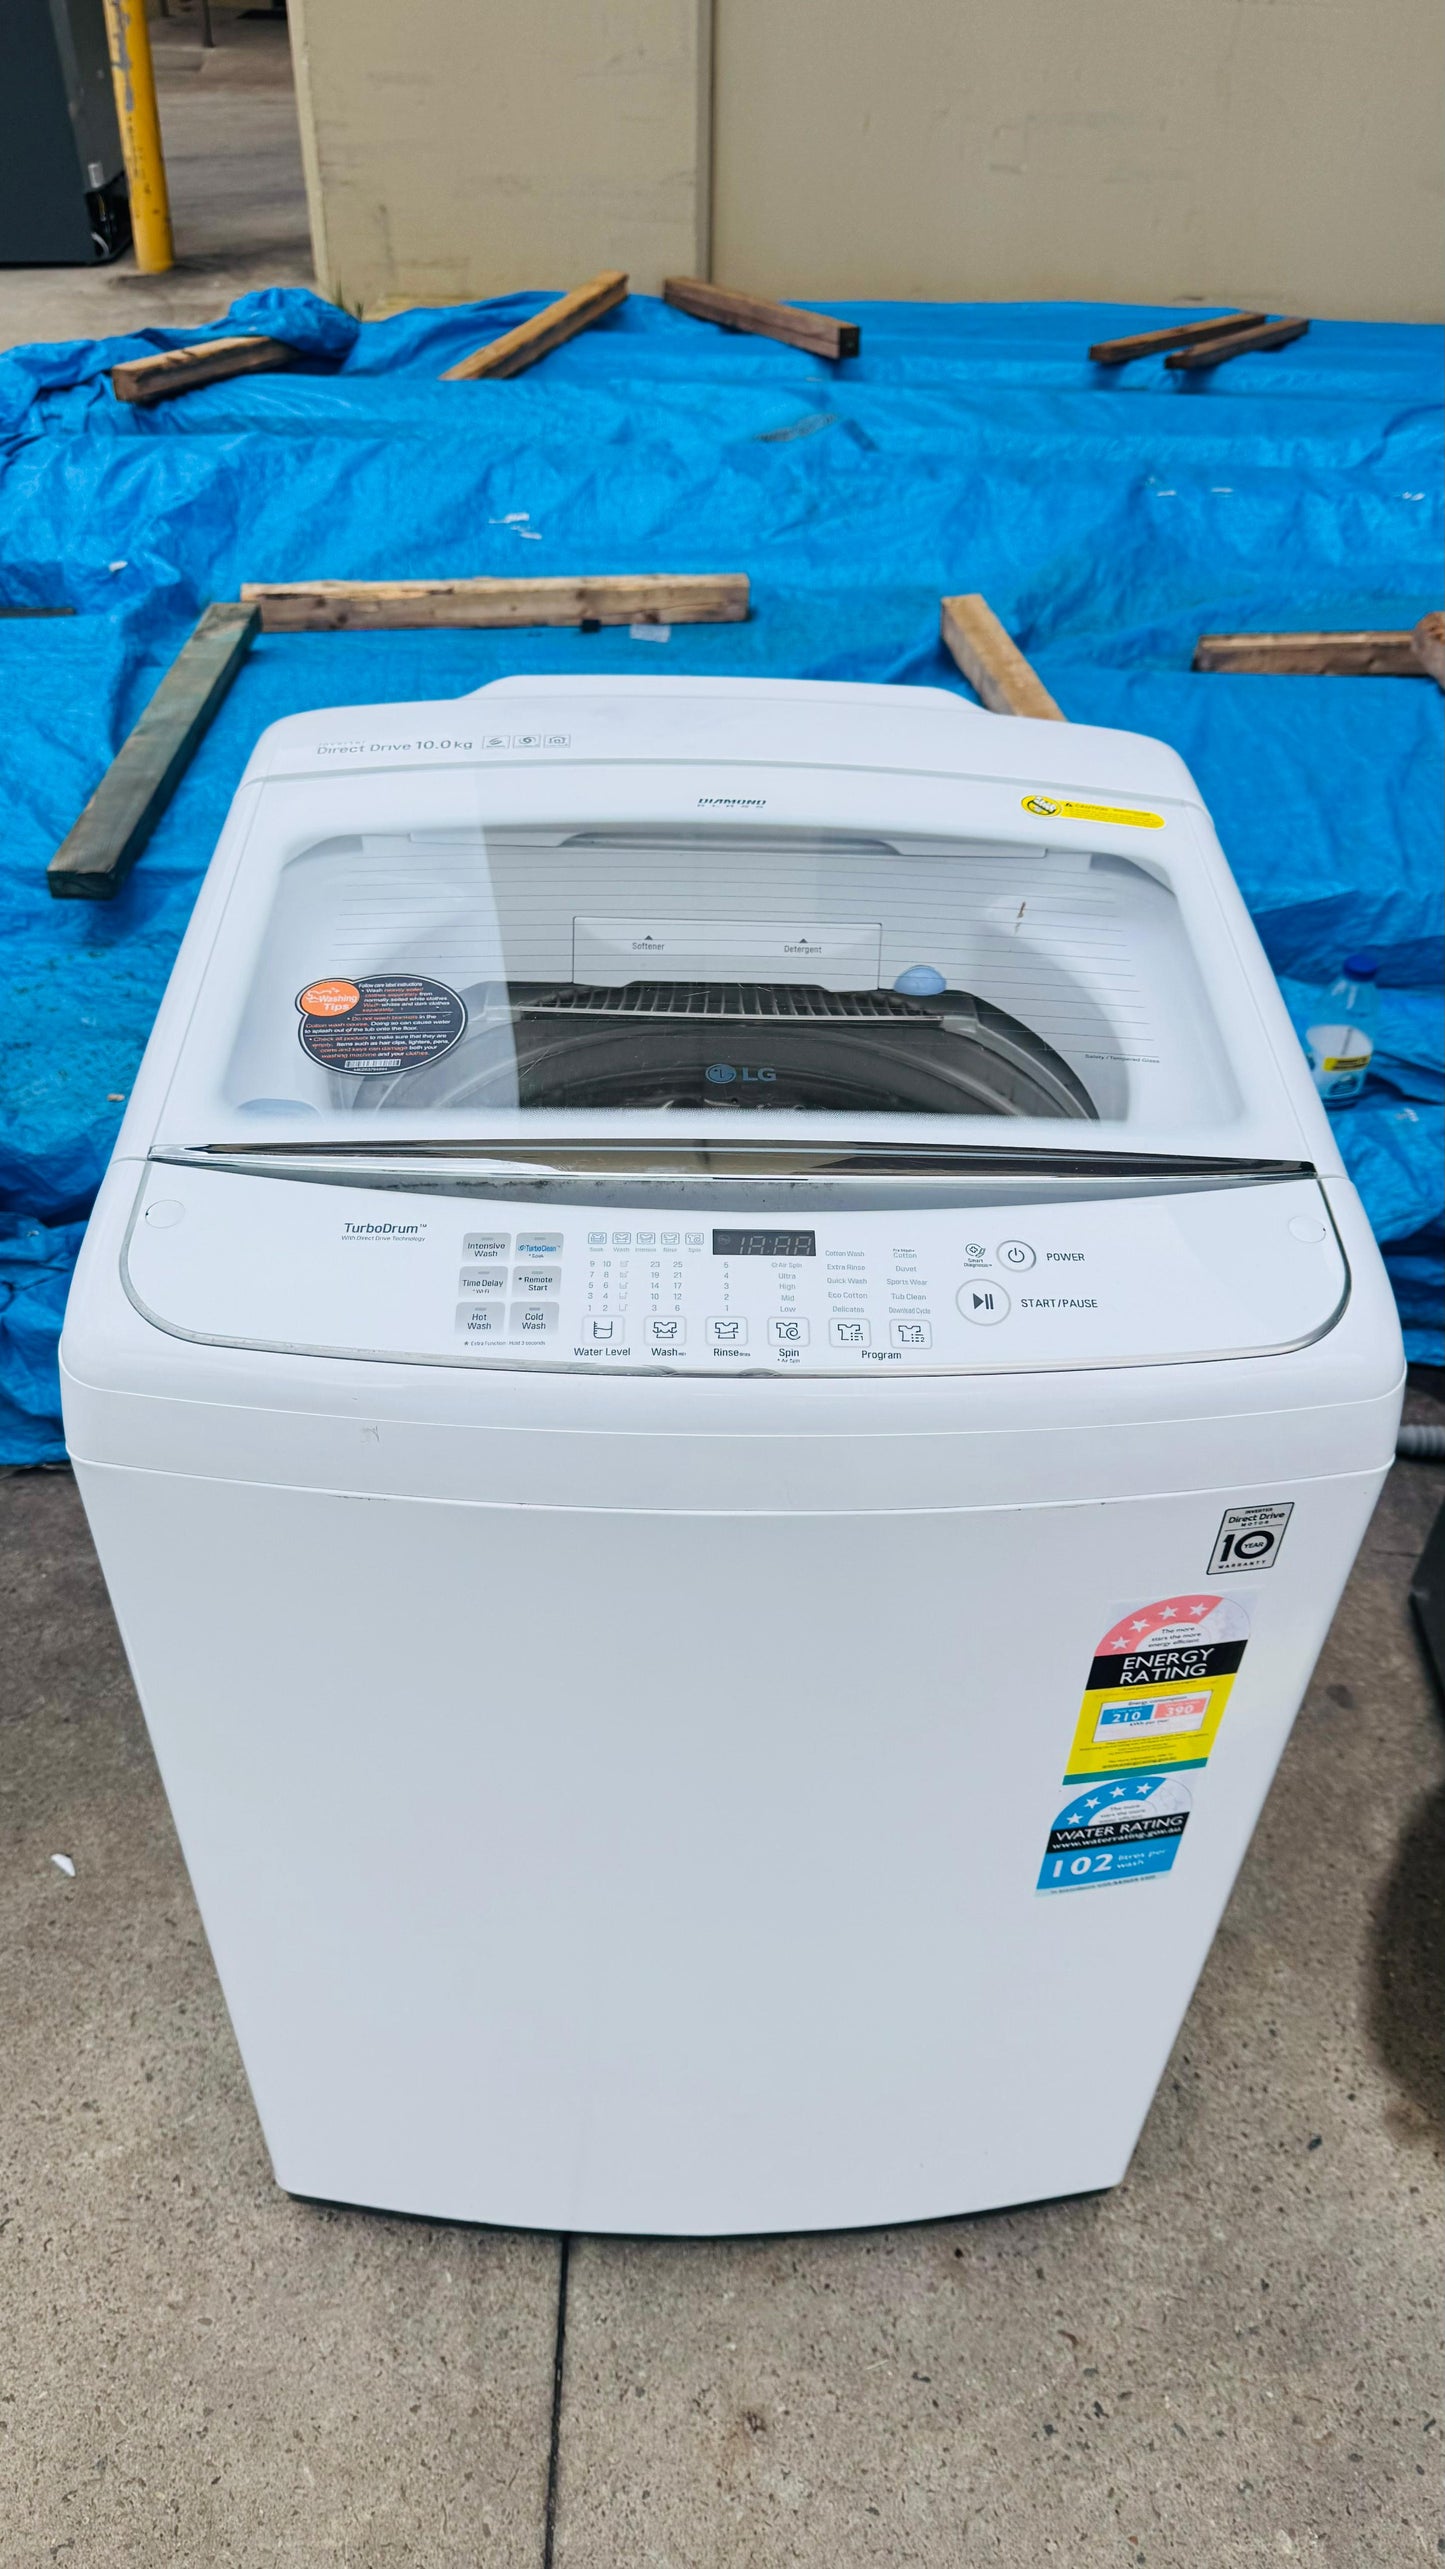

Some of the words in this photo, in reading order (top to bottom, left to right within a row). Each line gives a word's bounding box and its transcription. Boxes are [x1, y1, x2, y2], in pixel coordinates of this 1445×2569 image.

[317, 744, 364, 755] Direct
[370, 742, 411, 752] Drive
[632, 942, 665, 951] Softener
[784, 944, 822, 955] Detergent
[323, 1004, 349, 1012] Tips
[742, 1068, 777, 1082] LG
[468, 1242, 506, 1250] Intensive
[1046, 1252, 1086, 1262] POWER
[590, 1260, 595, 1268] 9
[603, 1260, 612, 1268] 10
[778, 1272, 796, 1280] Ultra
[482, 1280, 504, 1288] Delay
[826, 1277, 846, 1285] Quick
[779, 1283, 796, 1291] High
[781, 1294, 795, 1302] Mid
[524, 1312, 544, 1321] Cold
[467, 1322, 492, 1330] Wash
[522, 1322, 546, 1330] Wash
[574, 1348, 603, 1356] Water
[605, 1348, 631, 1356] Level
[651, 1348, 678, 1356] Wash
[713, 1348, 739, 1357] Rinse
[779, 1348, 800, 1359] Spin
[861, 1350, 902, 1361] Program
[1228, 1514, 1258, 1524] Direct
[1259, 1512, 1286, 1520] Drive
[1220, 1530, 1275, 1562] 10
[1218, 1560, 1267, 1569] WARRANTY
[1123, 1647, 1215, 1670] ENERGY
[1119, 1663, 1208, 1685] RATING
[1166, 1705, 1194, 1717] 390
[1112, 1712, 1142, 1723] 210
[1056, 1826, 1115, 1842] WATER
[1119, 1816, 1185, 1833] RATING
[1052, 1854, 1114, 1879] 102
[1117, 1860, 1145, 1869] wash
